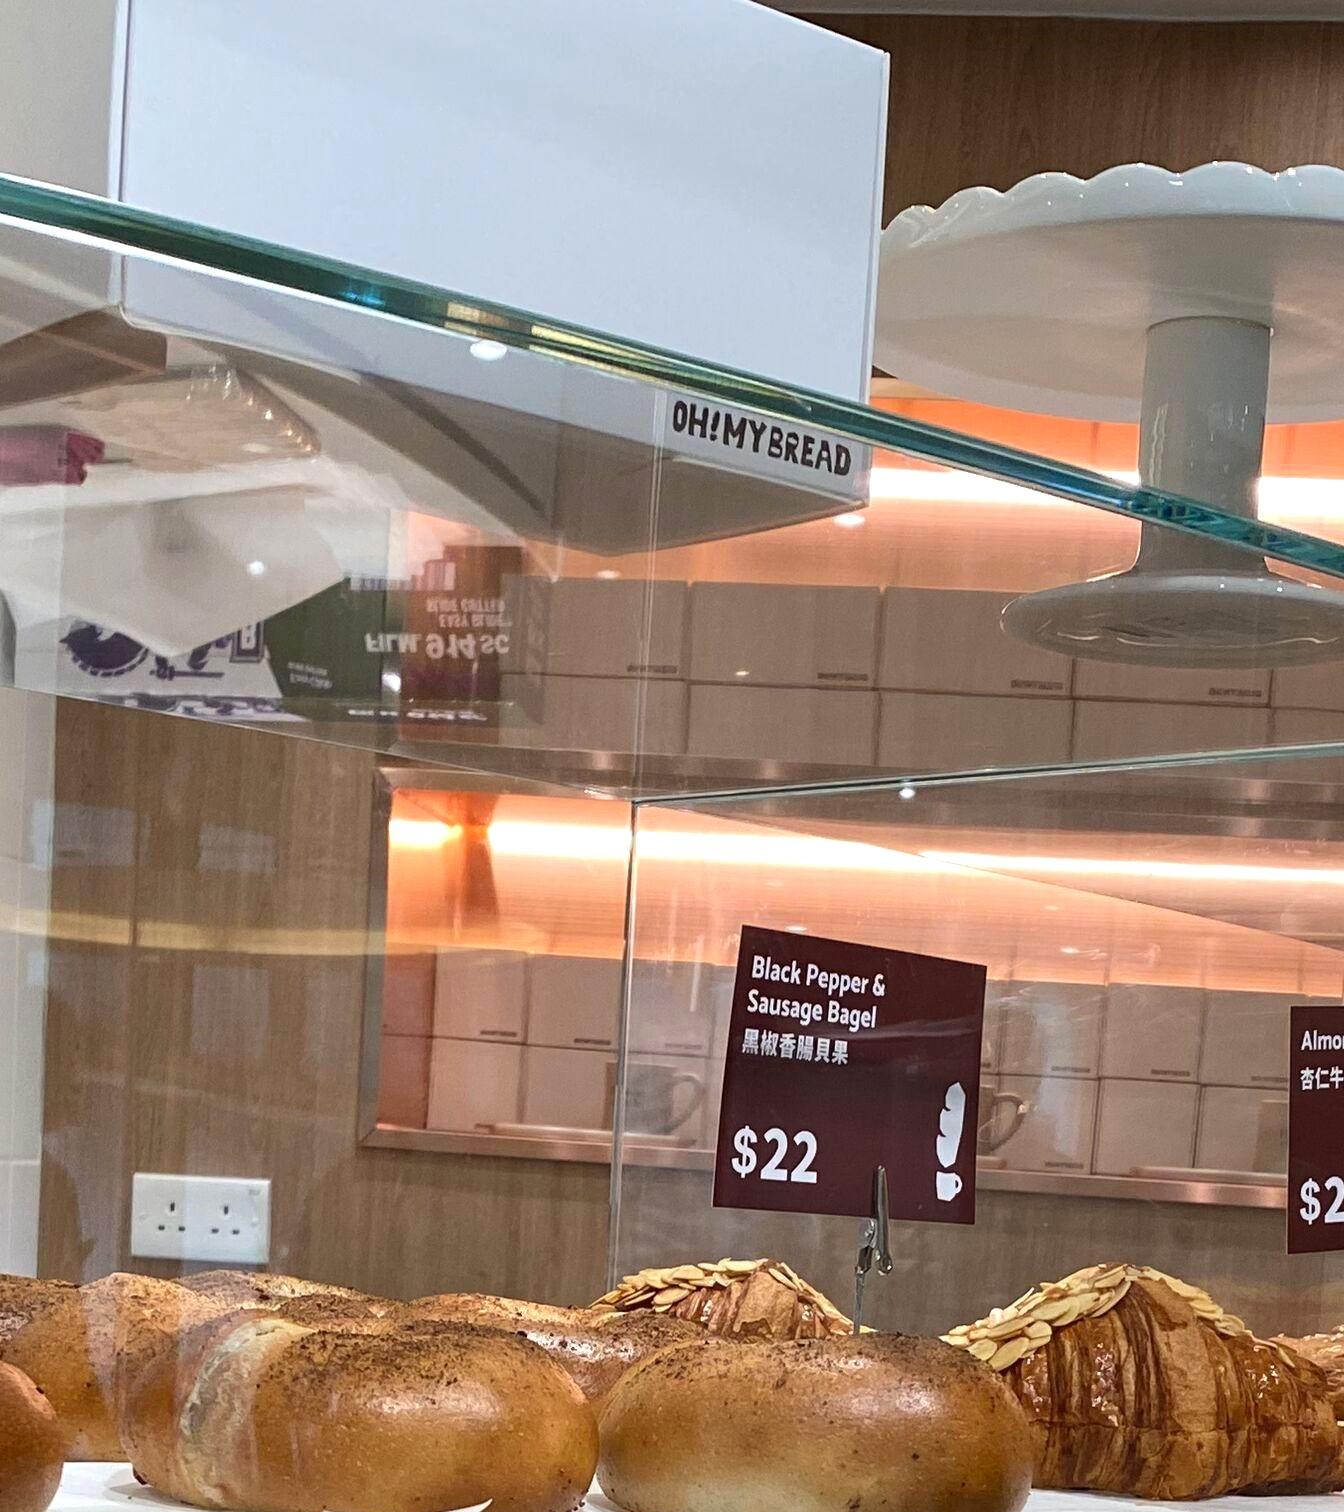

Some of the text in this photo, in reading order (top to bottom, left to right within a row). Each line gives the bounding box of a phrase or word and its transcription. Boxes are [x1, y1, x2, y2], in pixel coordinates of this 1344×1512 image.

[672, 400, 852, 476] OH!MYBREAD
[751, 954, 886, 998] Black Pepper &
[746, 989, 878, 1033] Sausage Bagel
[731, 1125, 818, 1185] $22
